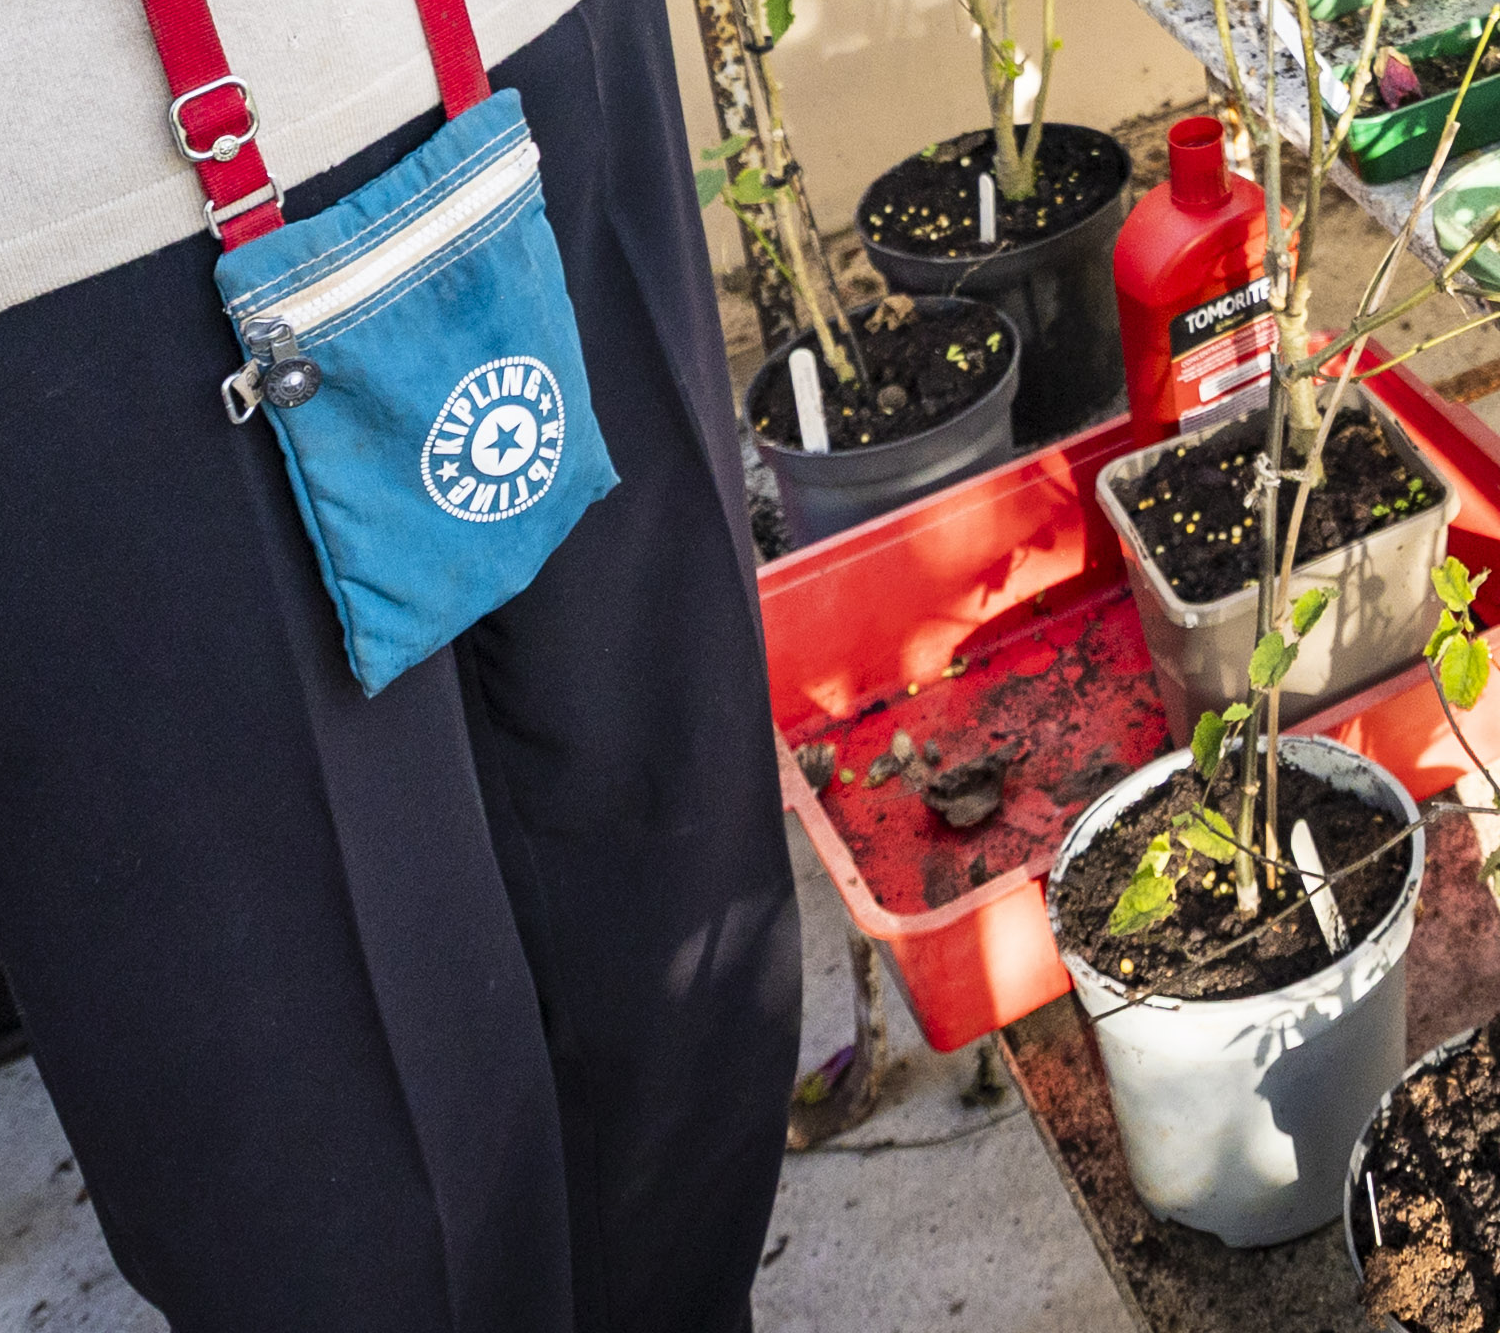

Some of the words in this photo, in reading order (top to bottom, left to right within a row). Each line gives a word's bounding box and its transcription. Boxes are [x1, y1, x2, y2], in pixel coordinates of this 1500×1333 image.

[1184, 276, 1271, 334] TOMORITE
[432, 365, 542, 455] KIPLING
[446, 419, 560, 513] KIPLING
